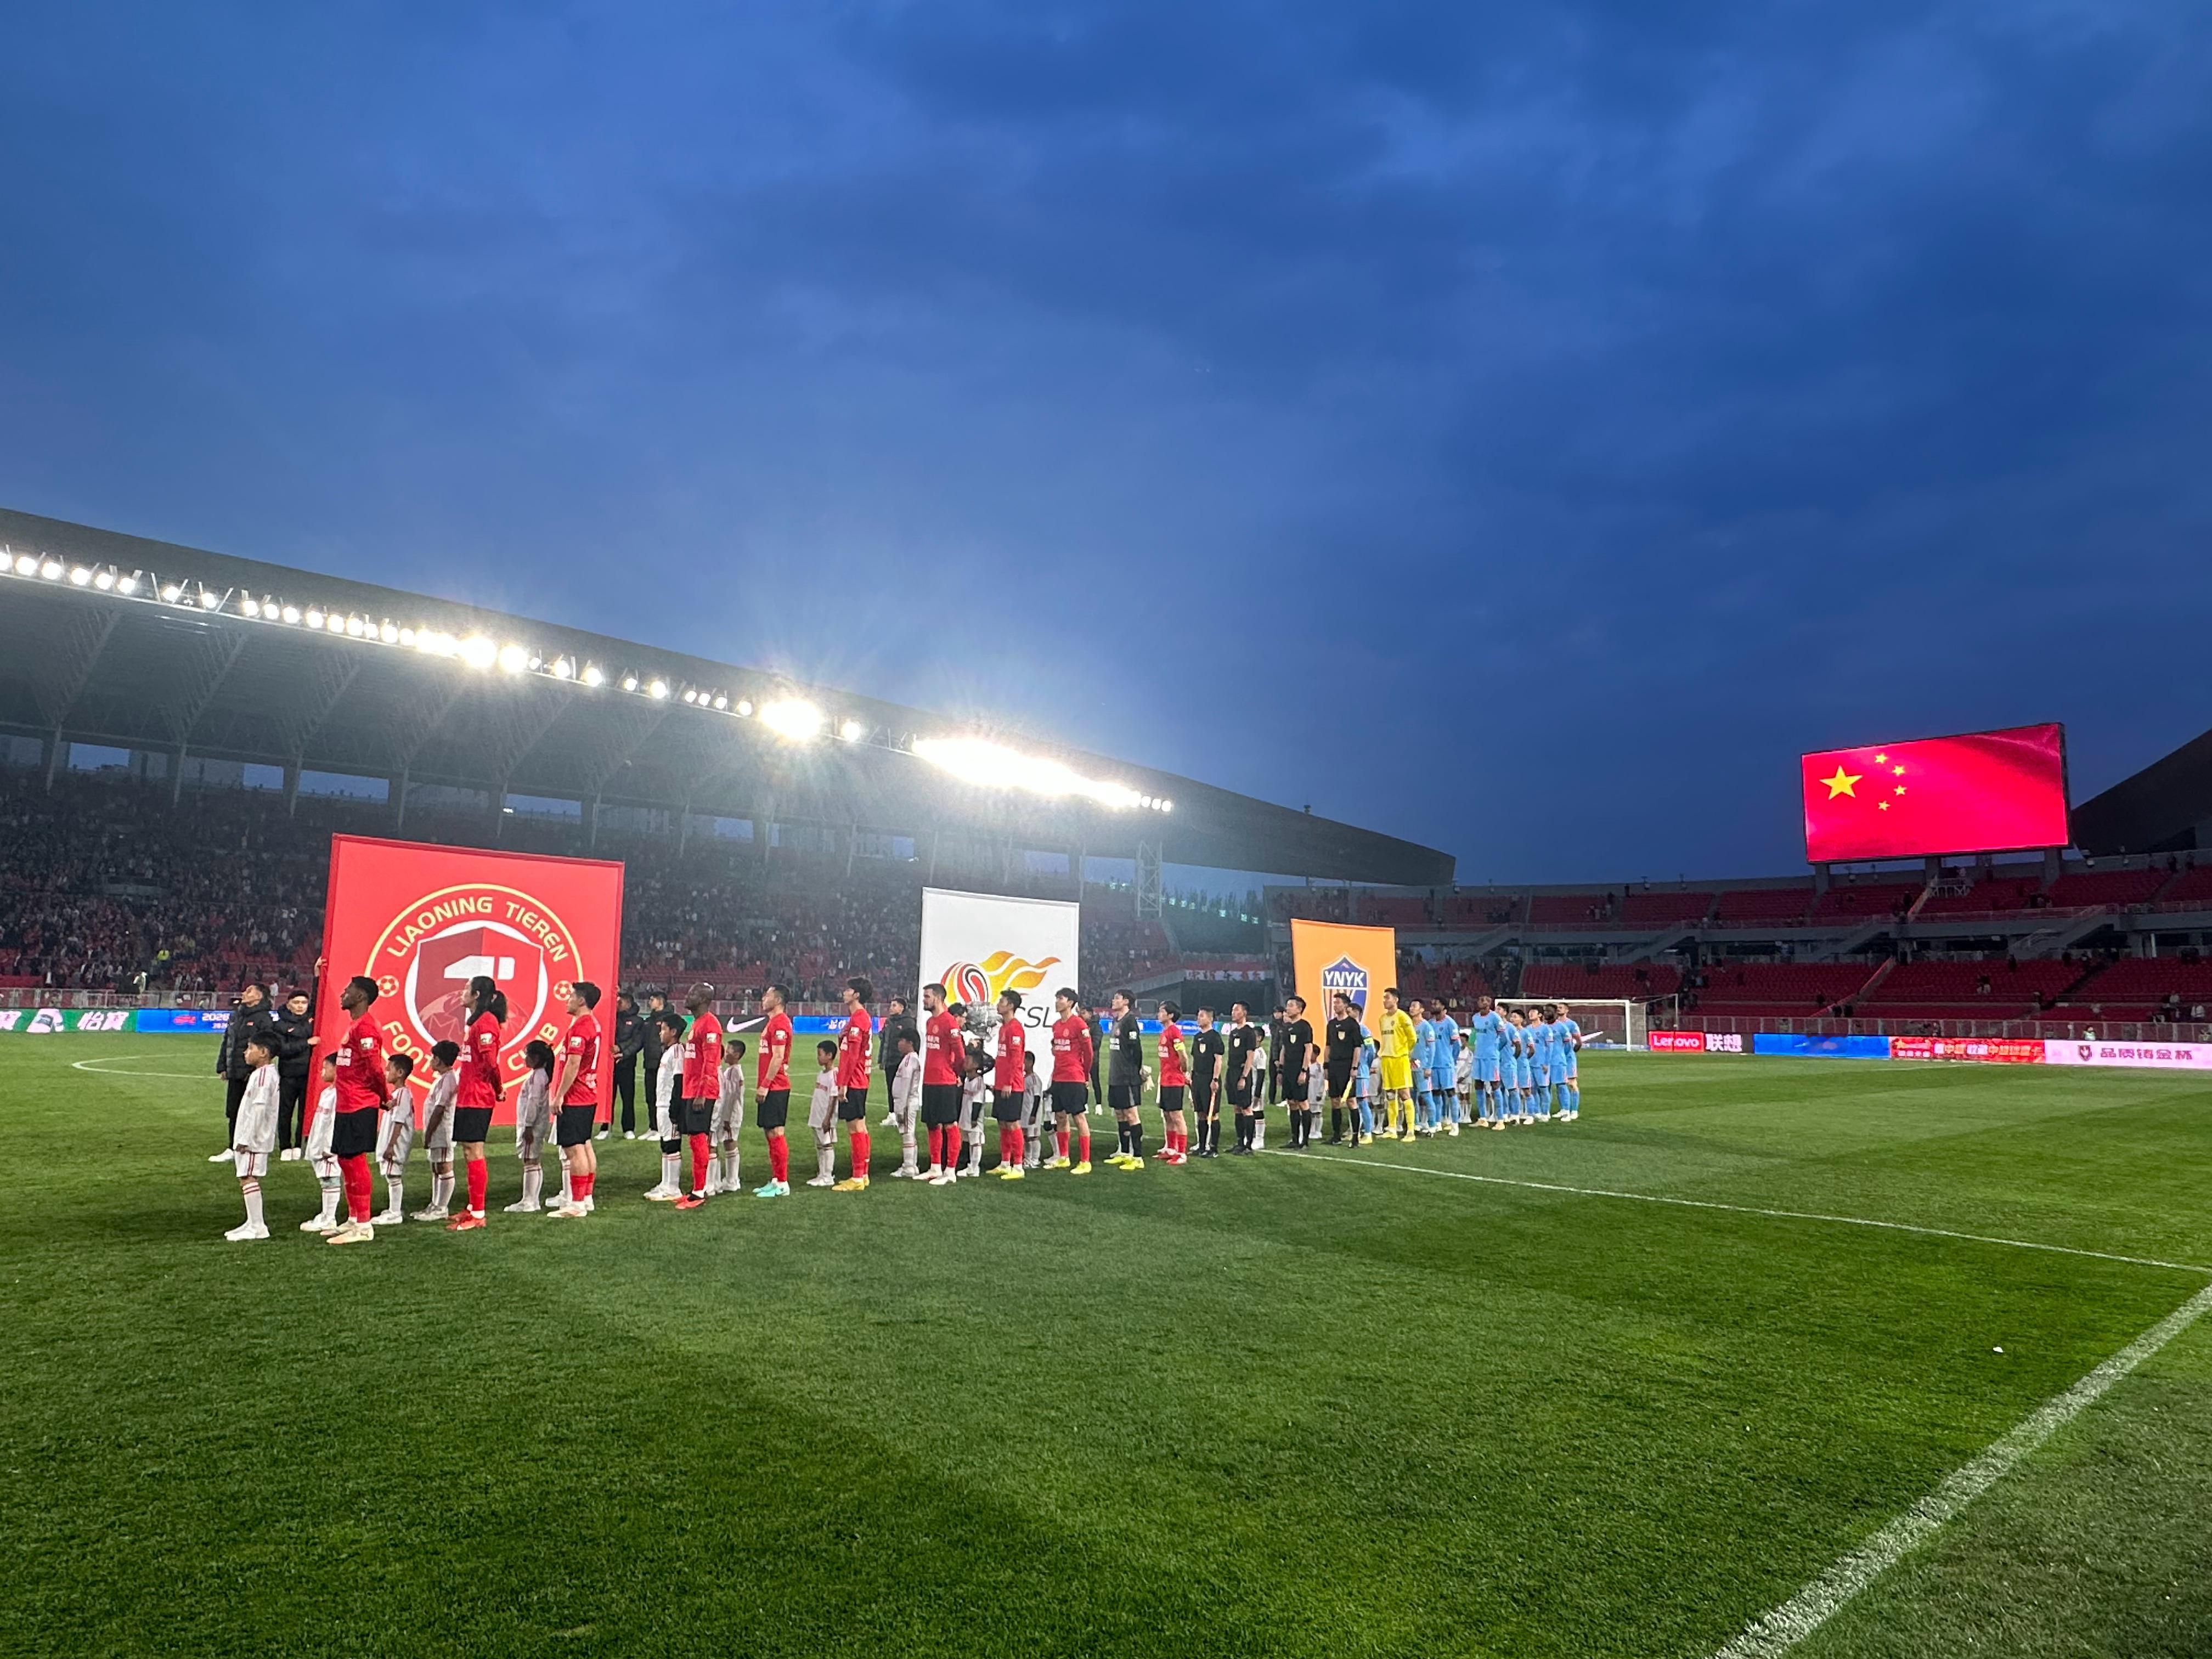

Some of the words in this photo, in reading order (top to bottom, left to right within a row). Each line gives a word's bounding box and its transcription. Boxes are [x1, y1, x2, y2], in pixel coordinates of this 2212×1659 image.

[387, 896, 493, 957] LIAONING
[506, 901, 568, 962] TIEREN
[1324, 970, 1365, 986] YNYK
[1017, 1006, 1053, 1028] SL
[507, 1023, 558, 1071] CB
